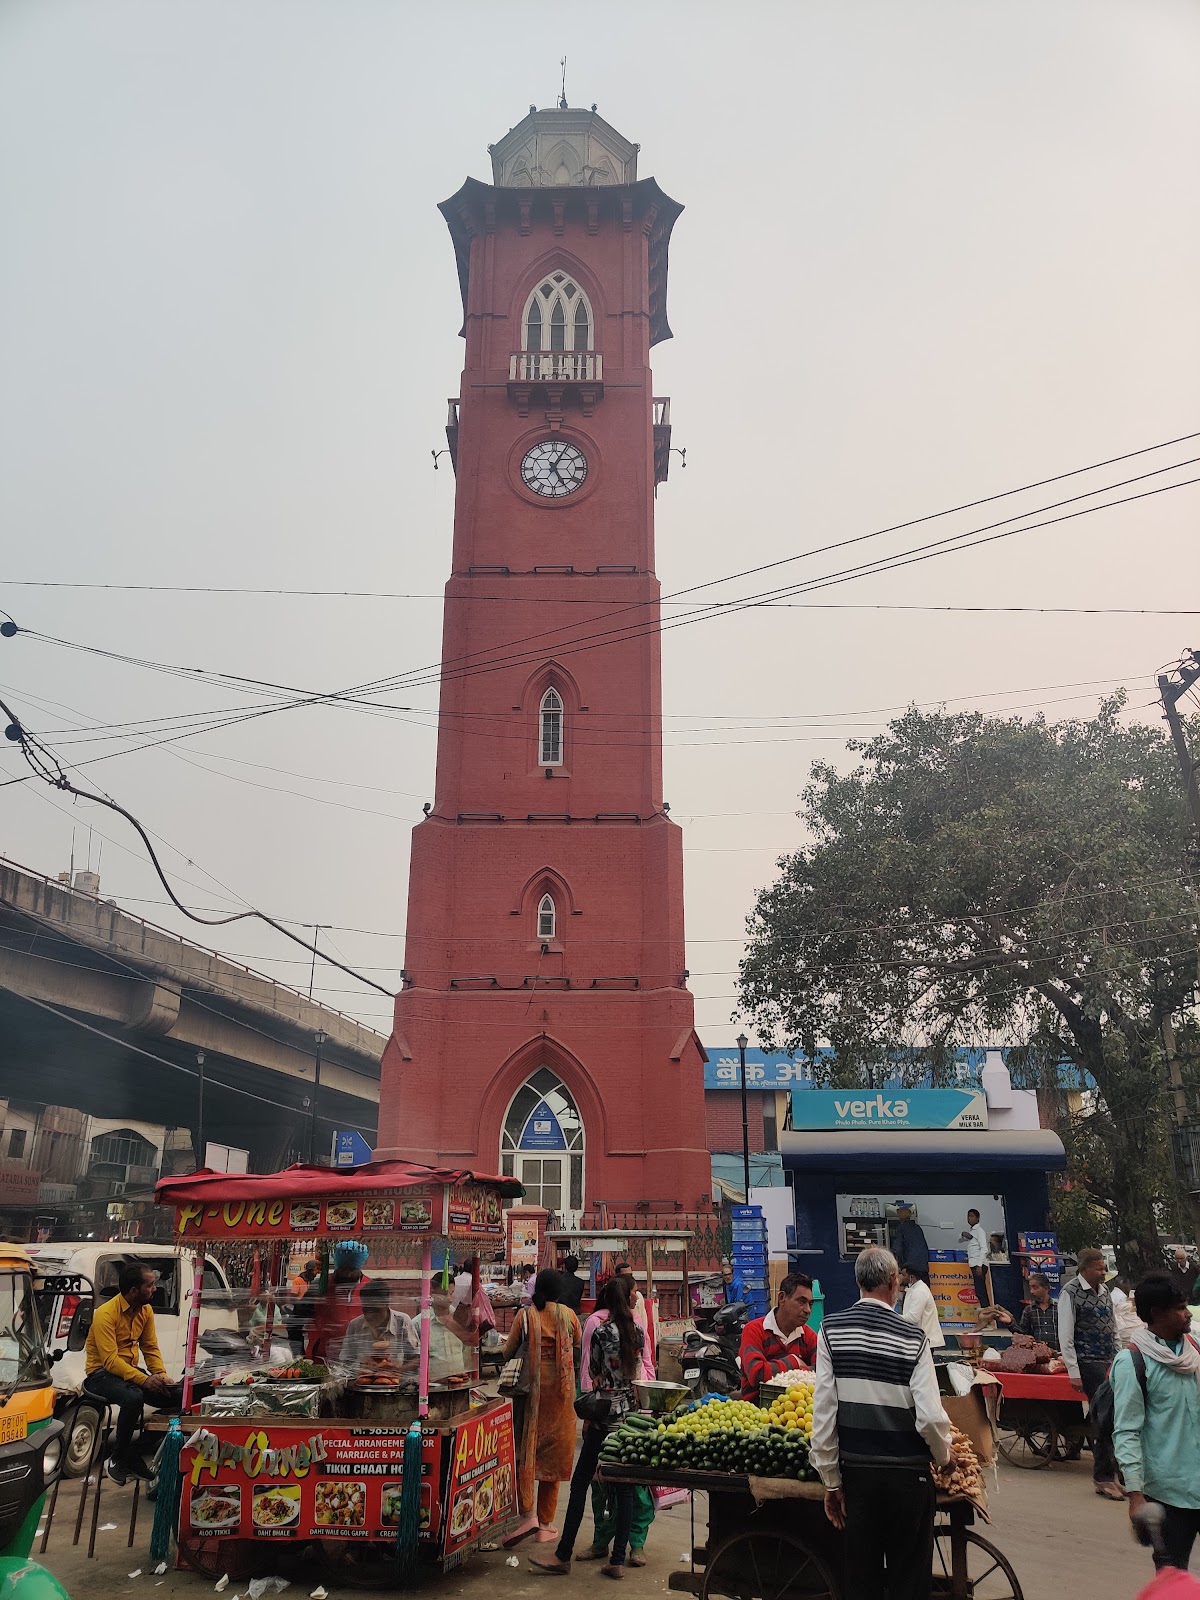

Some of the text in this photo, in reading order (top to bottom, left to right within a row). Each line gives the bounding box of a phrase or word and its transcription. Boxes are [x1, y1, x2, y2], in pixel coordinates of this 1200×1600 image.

[716, 1057, 765, 1081] बैंक
[834, 1094, 909, 1118] verka
[0, 1173, 23, 1185] ATARIA
[178, 1199, 285, 1234] A-One
[933, 1293, 952, 1301] erka
[323, 1439, 435, 1448] PECIAL ARRANGEME OR
[336, 1451, 380, 1459] MARRIAGE
[382, 1451, 388, 1459] &
[455, 1420, 498, 1480] A-One
[325, 1464, 350, 1474] TIKKI
[353, 1464, 388, 1474] CHAAT
[351, 1529, 369, 1537] GAPPE
